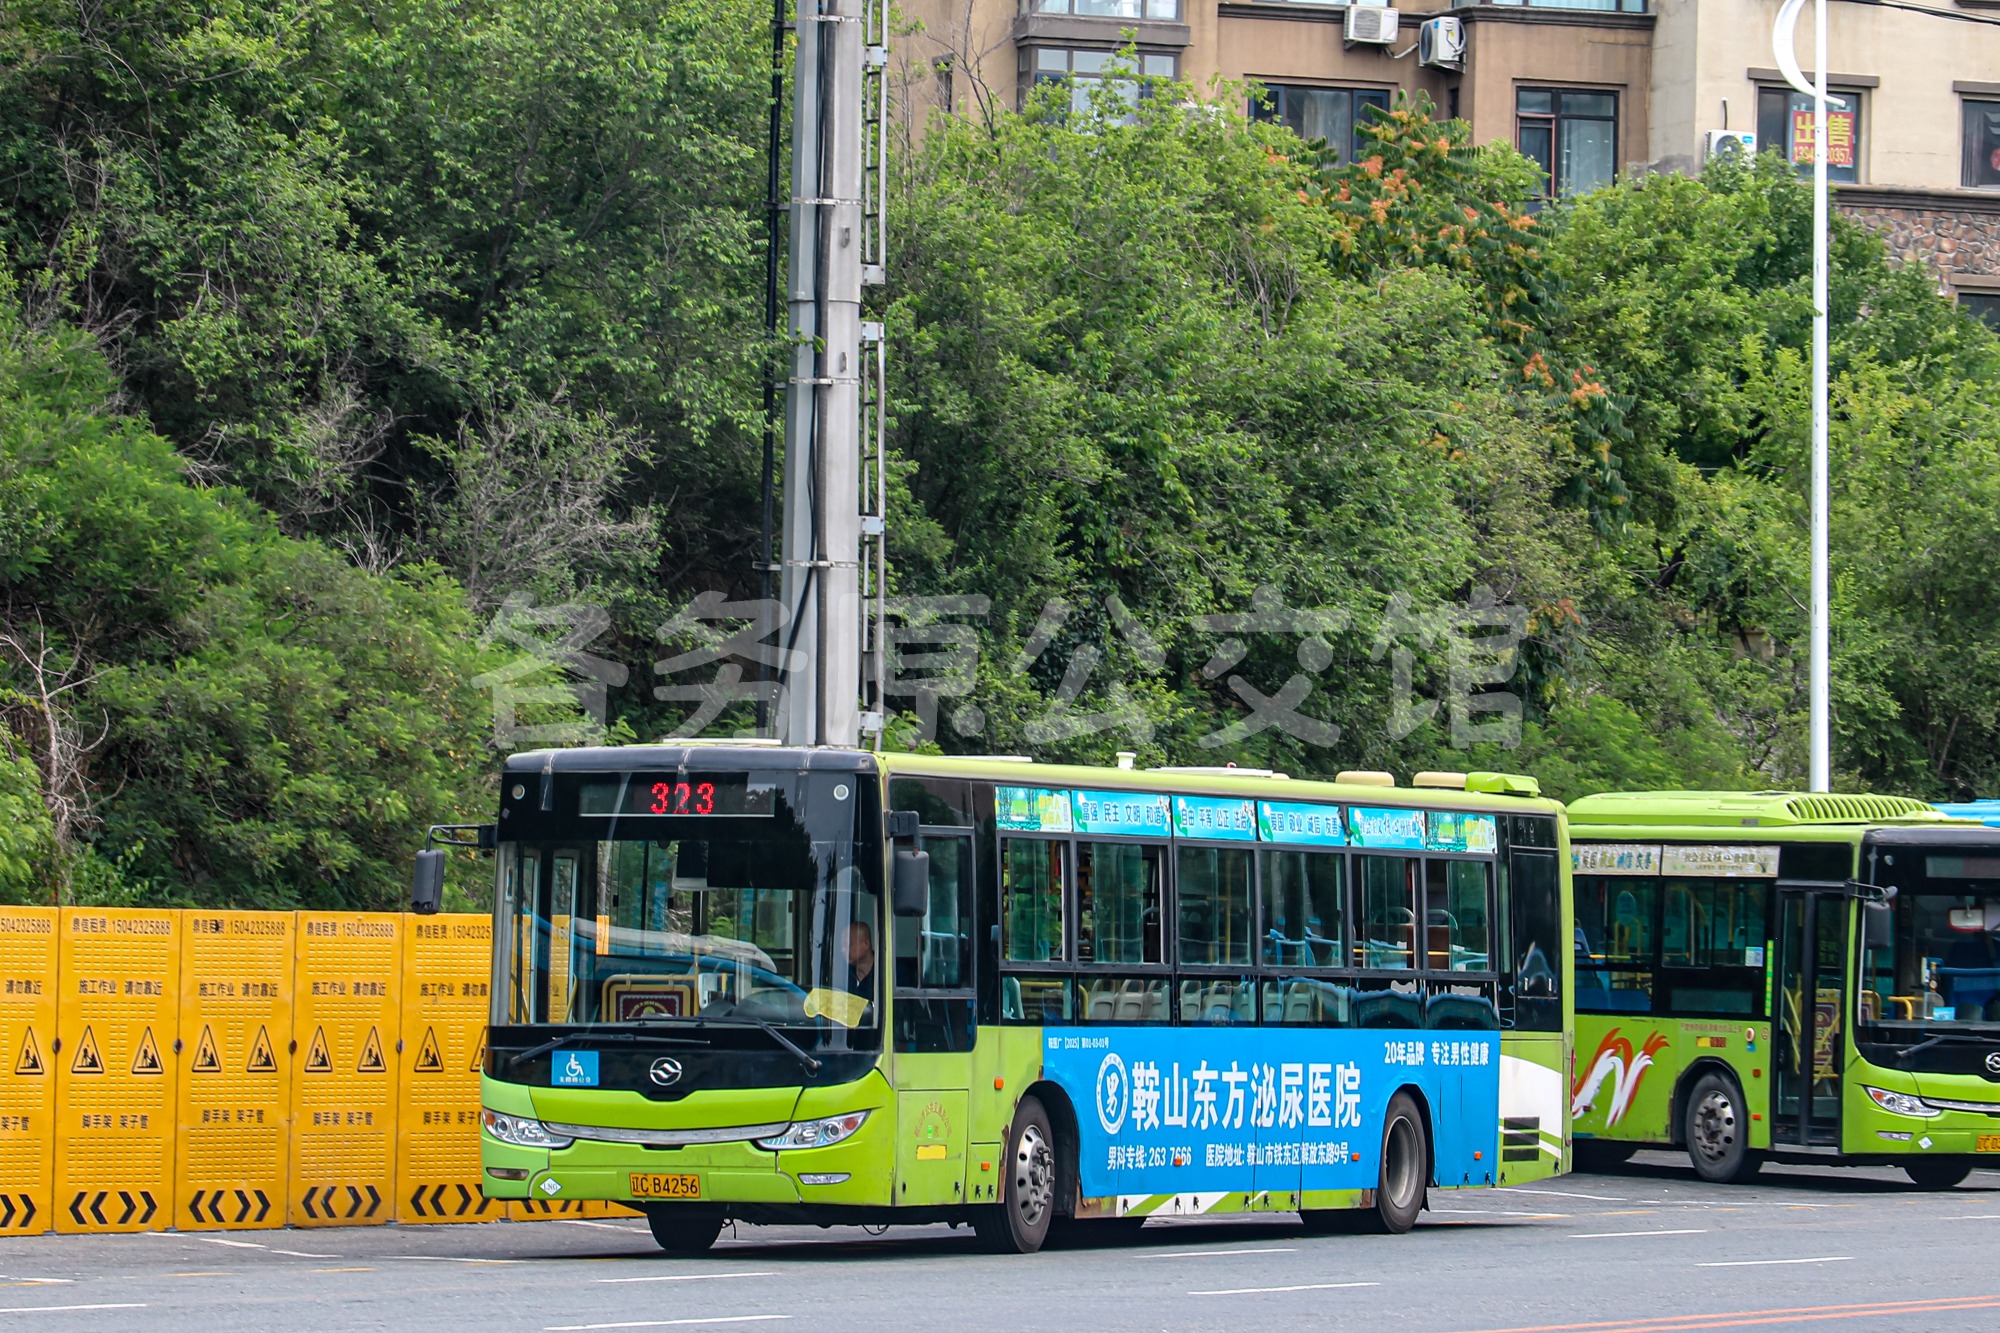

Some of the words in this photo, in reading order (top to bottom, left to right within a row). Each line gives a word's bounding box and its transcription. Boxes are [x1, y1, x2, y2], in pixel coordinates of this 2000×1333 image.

[1795, 113, 1851, 147] 出售
[650, 782, 715, 815] 323
[1081, 802, 1099, 822] 富强
[1104, 802, 1120, 823] 民主
[1124, 803, 1141, 824] 文明
[1146, 805, 1162, 825] 和谐
[1180, 807, 1195, 826] 自由
[1199, 808, 1213, 828] 平等
[1216, 809, 1230, 829] 公正
[1270, 812, 1285, 832] 爱国
[1288, 812, 1303, 833] 敬业
[1306, 814, 1321, 834] 诚信
[1324, 815, 1339, 836] 友善
[416, 924, 491, 939] 鼎信租赁:15042325
[6, 979, 42, 996] 请勿靠近
[79, 978, 117, 995] 施工作业
[125, 980, 163, 996] 请勿靠近
[198, 982, 235, 997] 施工作业
[241, 982, 278, 997] 请勿靠近
[312, 981, 346, 996] 施工作业
[353, 982, 387, 997] 请勿靠近
[420, 983, 455, 997] 施工作业
[462, 983, 488, 997] 请勿靠
[1384, 1041, 1425, 1066] 20年品牌
[1431, 1041, 1489, 1066] 专注男性健康
[1131, 1060, 1362, 1132] 鞍山东方泌尿医院
[543, 1182, 558, 1190] LNG
